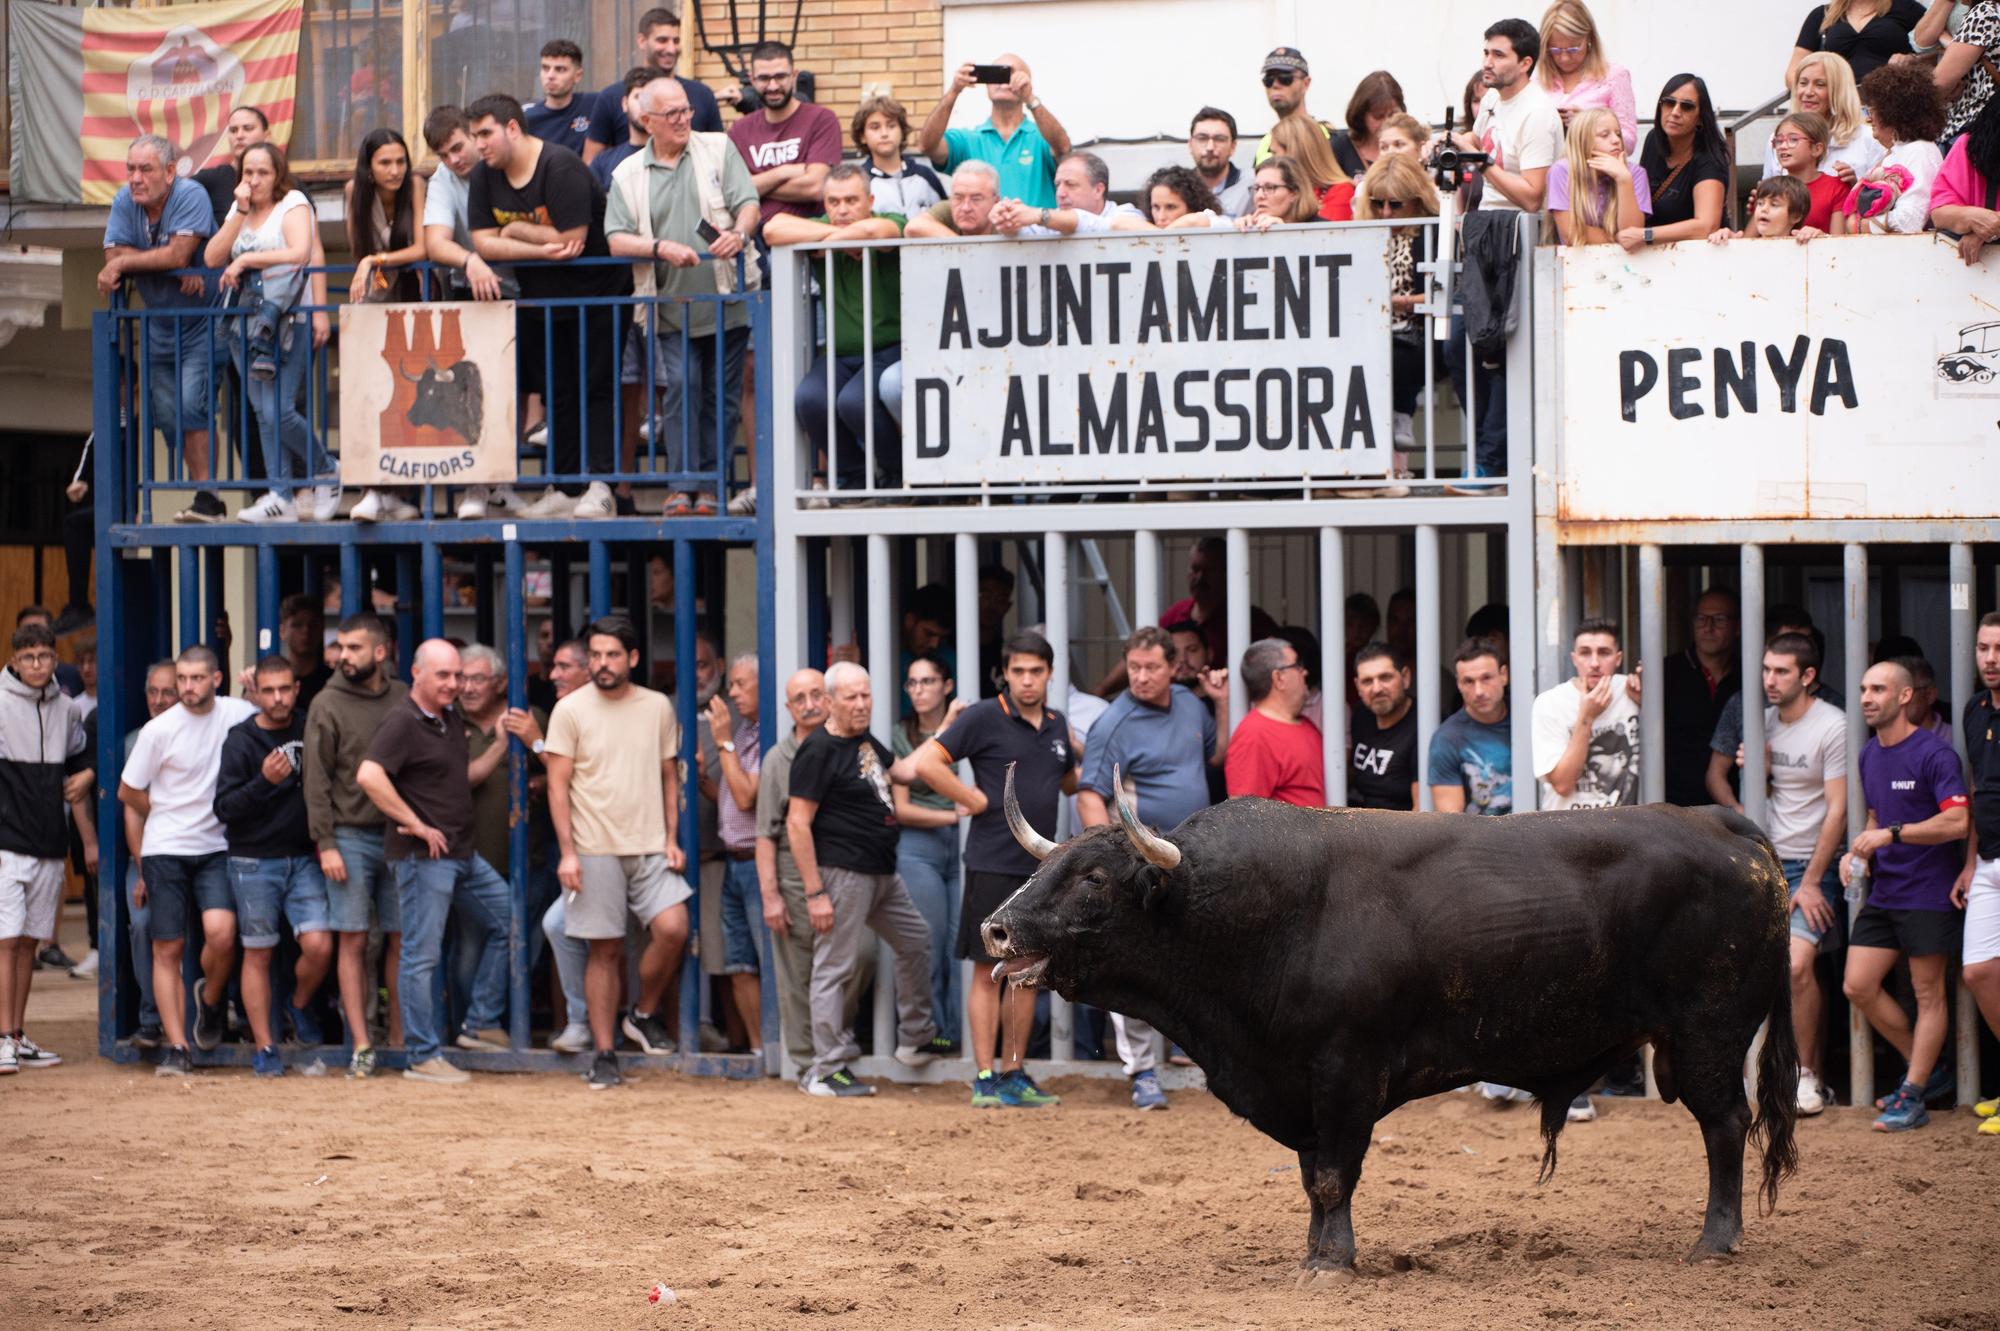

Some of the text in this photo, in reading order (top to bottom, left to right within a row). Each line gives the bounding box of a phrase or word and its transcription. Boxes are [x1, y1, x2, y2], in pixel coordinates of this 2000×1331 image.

[749, 137, 801, 168] VANS
[938, 253, 1353, 350] AJUNTAMENT
[1619, 334, 1859, 423] PENYA
[999, 365, 1377, 457] ALMASSORA
[379, 450, 475, 479] CLAFIDORS
[1353, 742, 1394, 775] EA7
